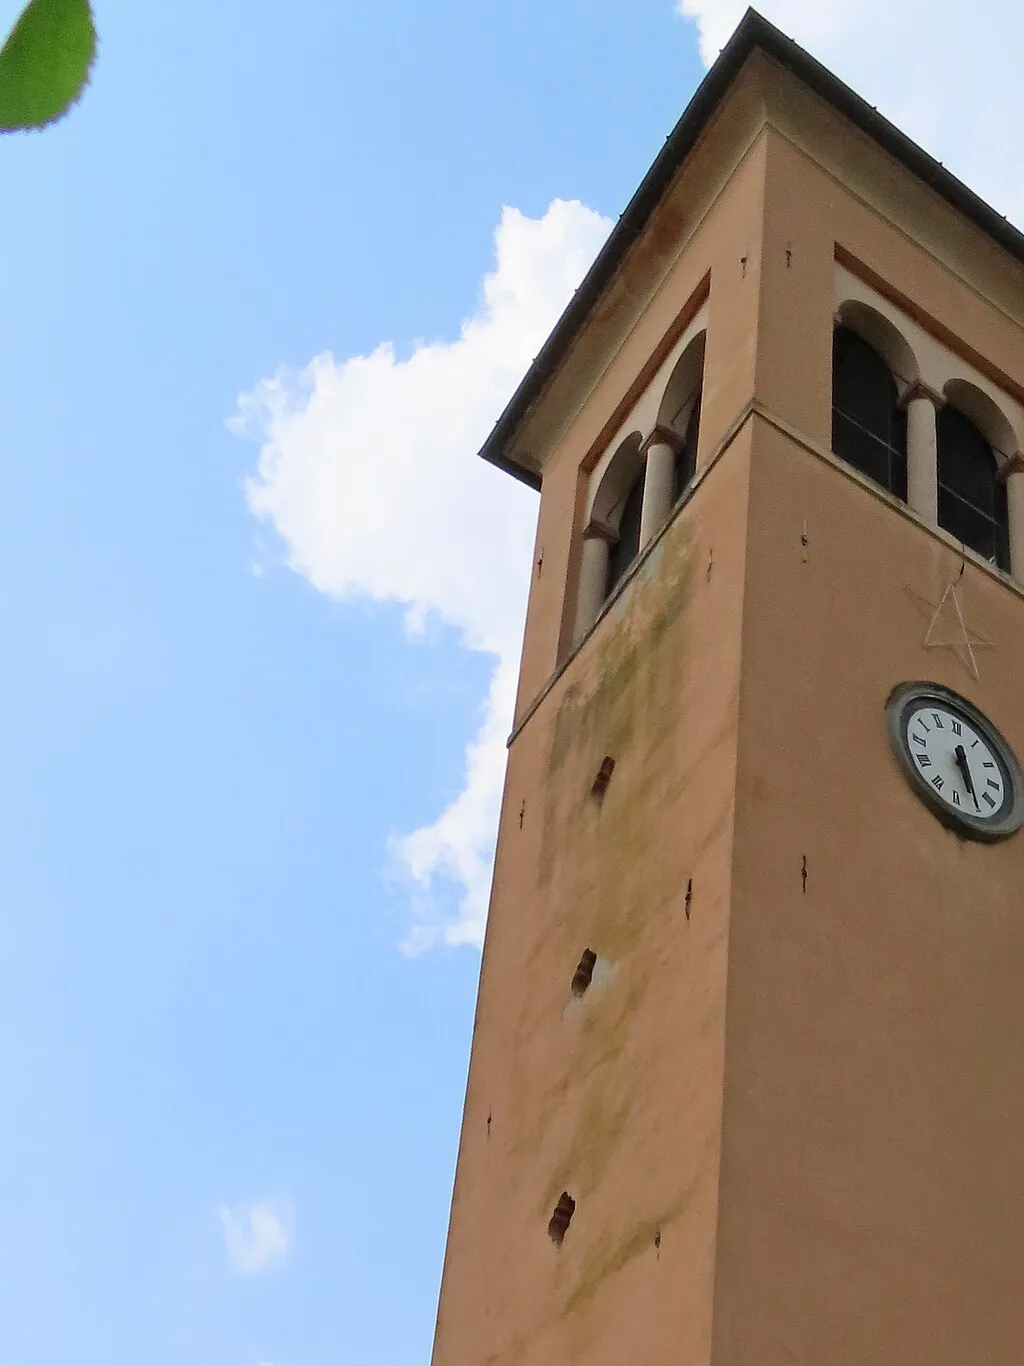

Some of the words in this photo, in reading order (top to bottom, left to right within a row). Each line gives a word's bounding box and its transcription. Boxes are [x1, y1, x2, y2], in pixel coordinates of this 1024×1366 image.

[951, 720, 962, 737] XII
[971, 739, 979, 748] I
[931, 775, 945, 791] VII
[986, 778, 1000, 791] III
